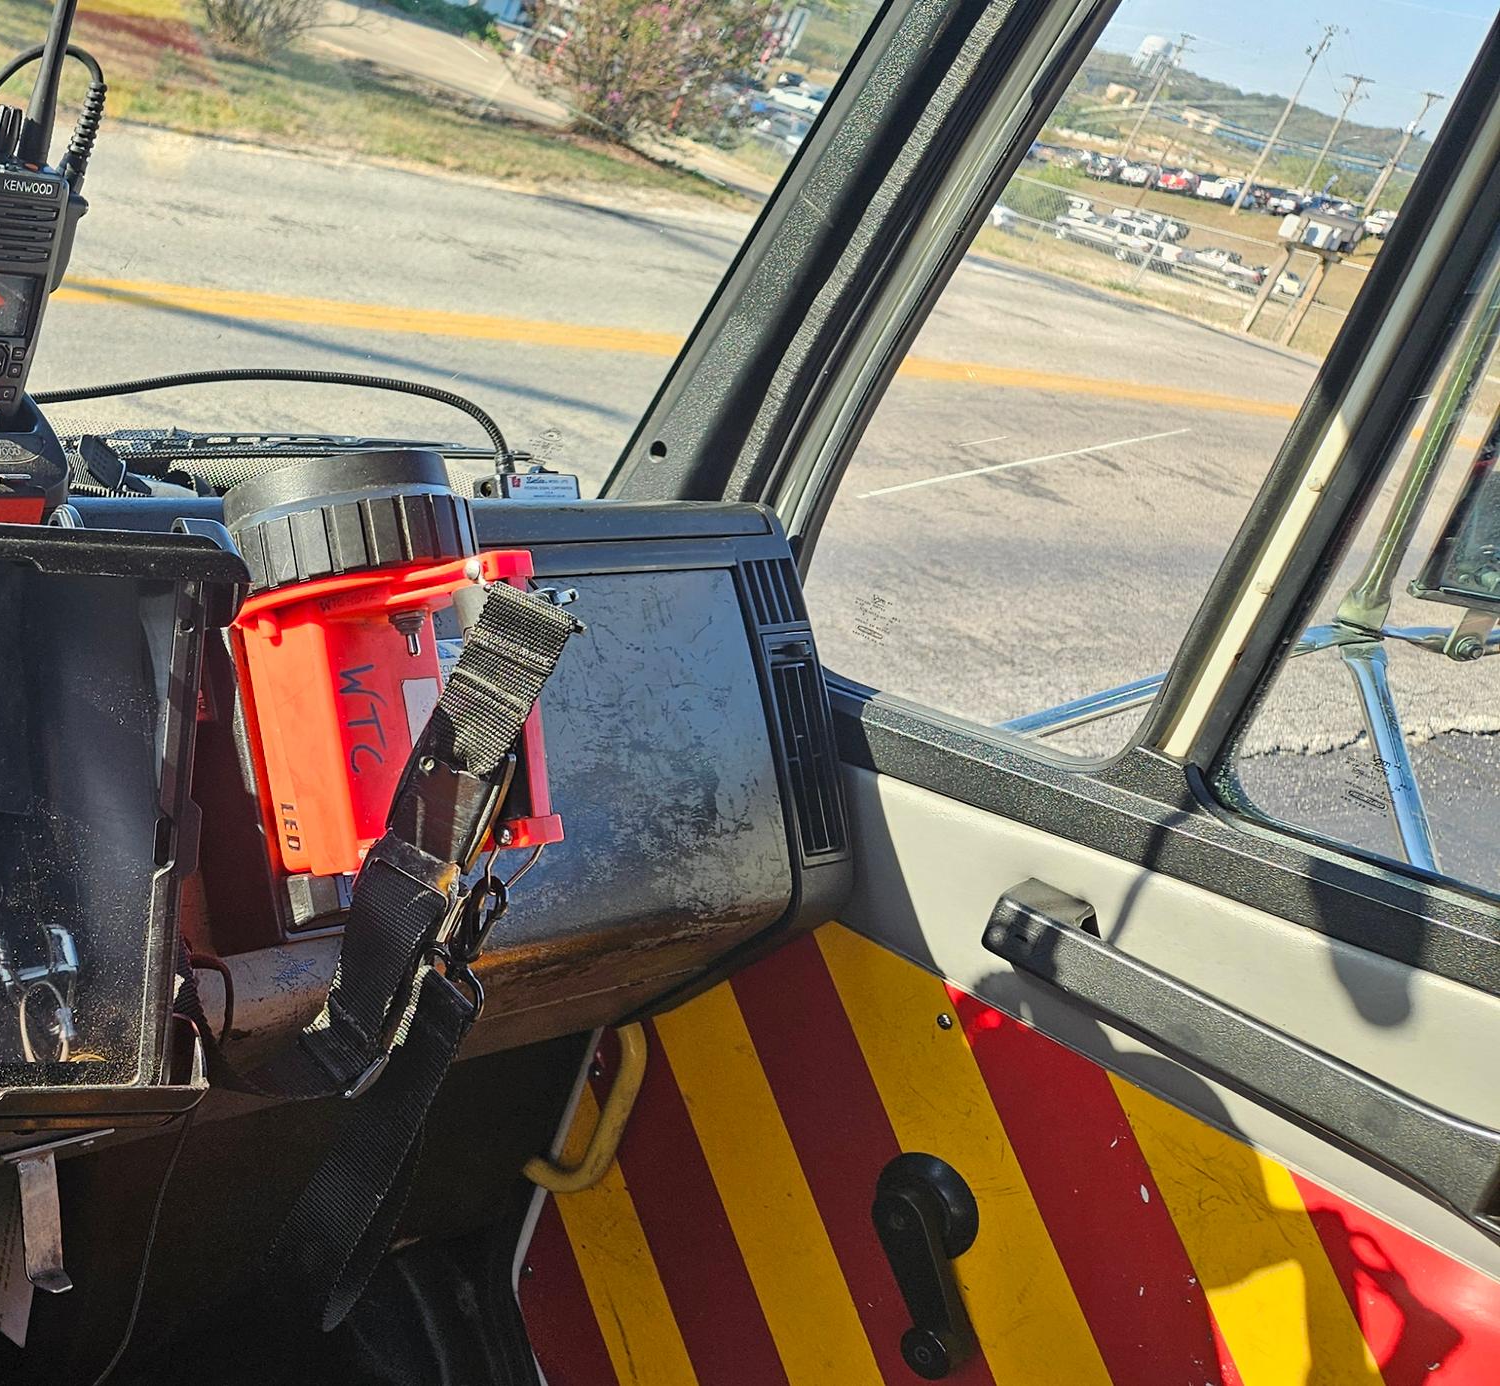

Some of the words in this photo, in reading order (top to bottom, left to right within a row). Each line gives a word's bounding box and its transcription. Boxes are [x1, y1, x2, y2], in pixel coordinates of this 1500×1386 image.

[3, 179, 53, 195] KENWOOD
[3, 390, 10, 399] C
[339, 664, 389, 774] WTC
[281, 803, 301, 851] LED
